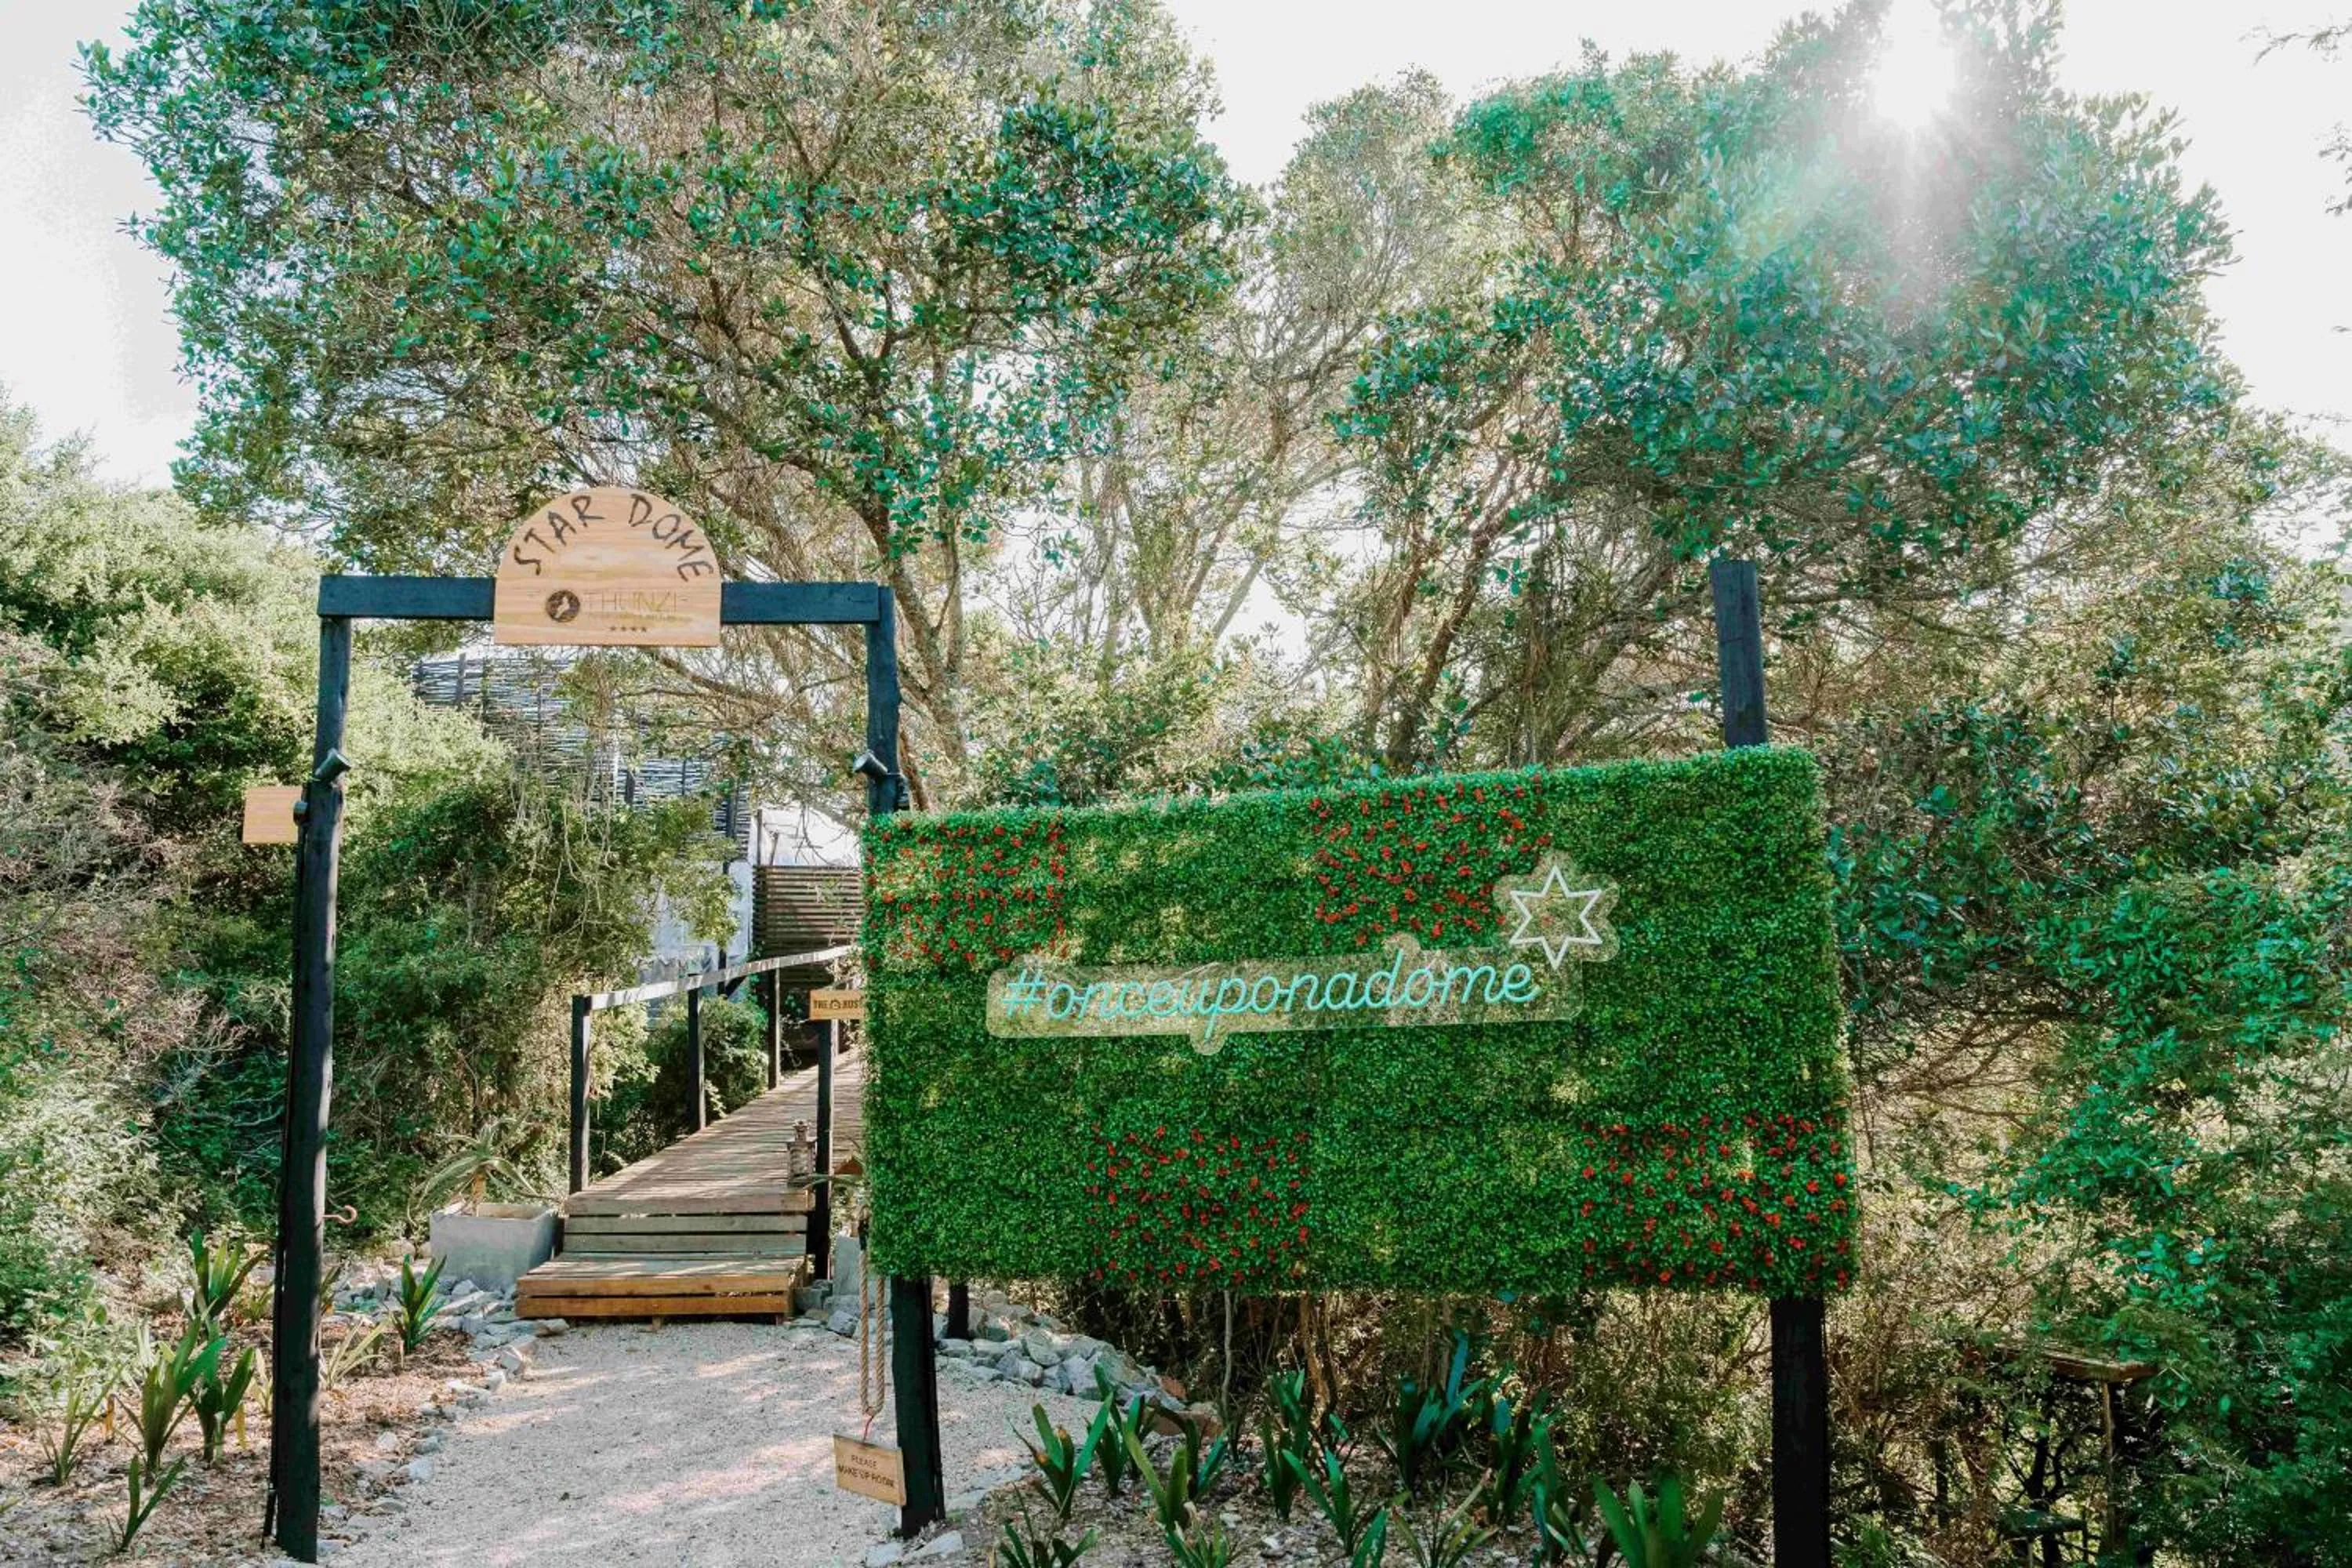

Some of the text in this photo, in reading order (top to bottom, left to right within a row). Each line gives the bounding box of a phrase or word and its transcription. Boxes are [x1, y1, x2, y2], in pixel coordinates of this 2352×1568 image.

[514, 494, 713, 582] STAR DOME
[813, 1000, 828, 1009] THE
[1003, 948, 1542, 1043] #onceuponadome
[851, 1454, 877, 1469] PLEASE
